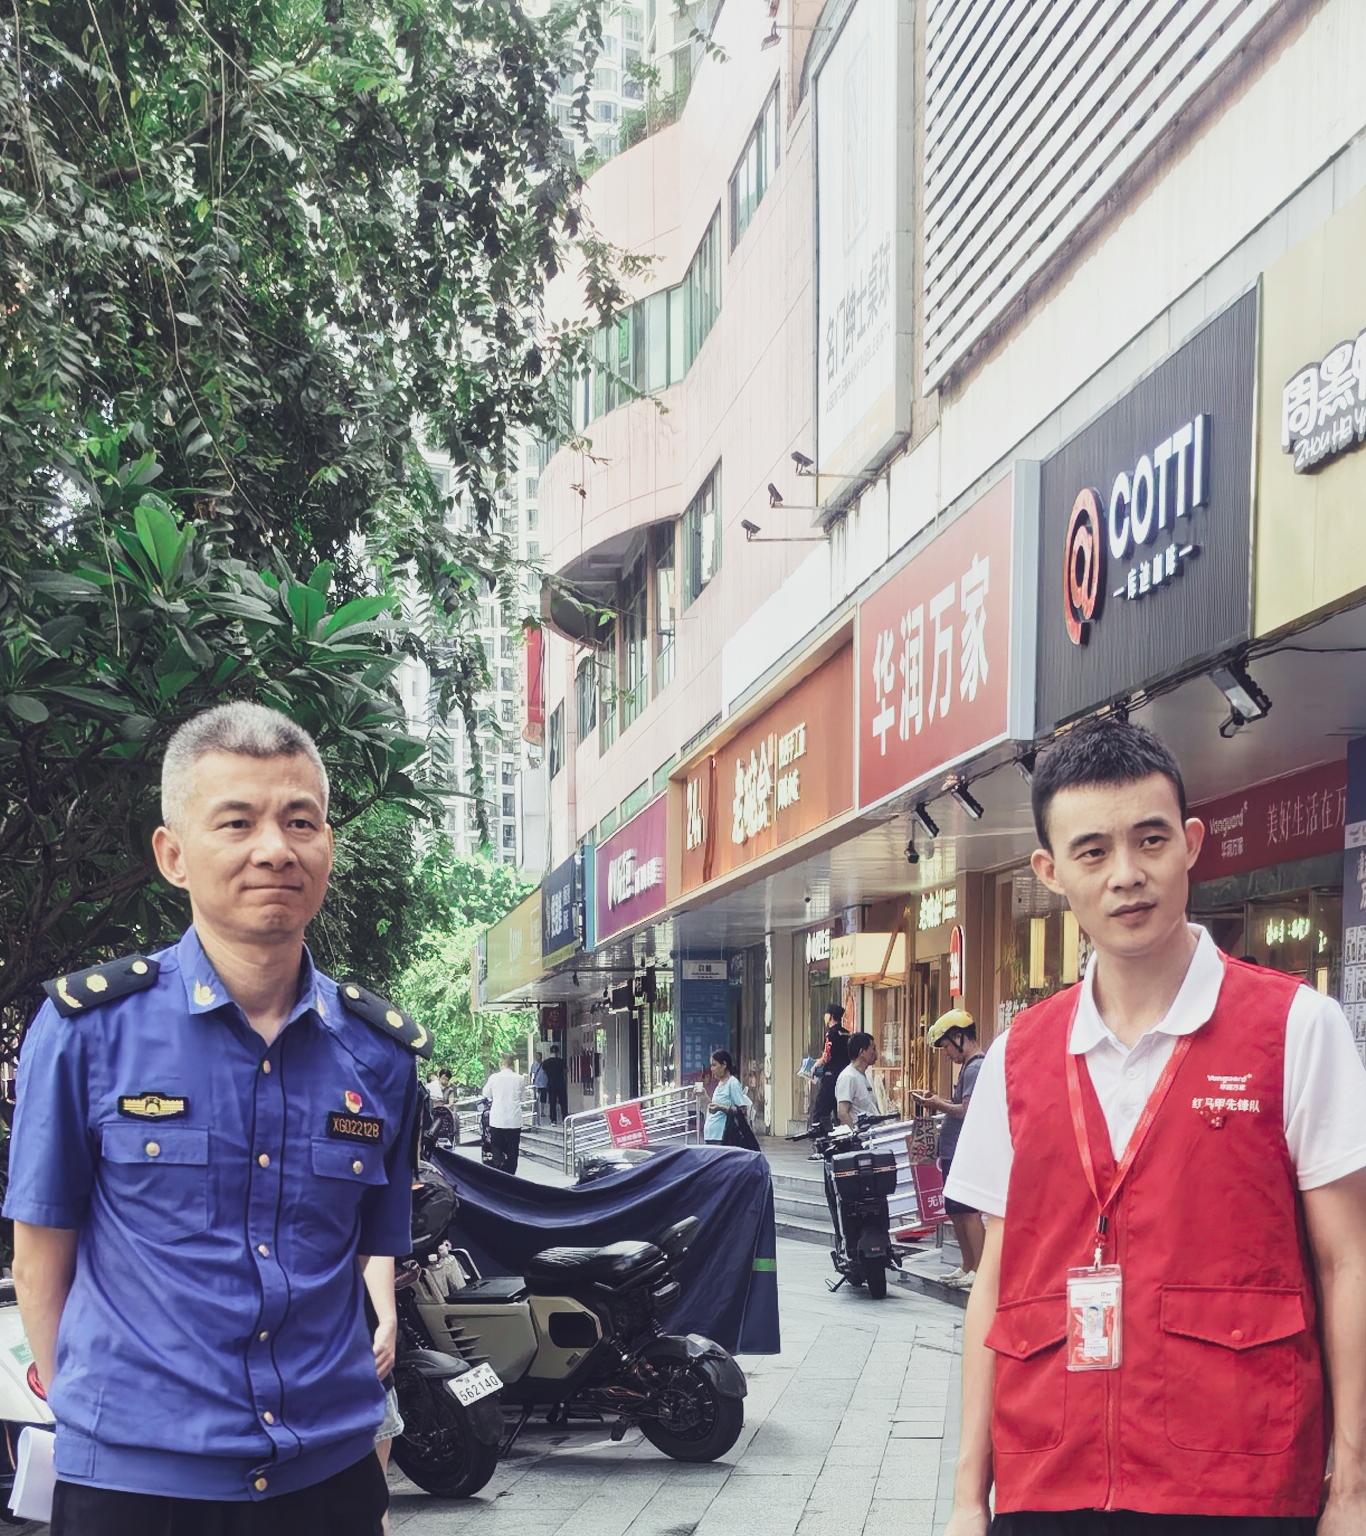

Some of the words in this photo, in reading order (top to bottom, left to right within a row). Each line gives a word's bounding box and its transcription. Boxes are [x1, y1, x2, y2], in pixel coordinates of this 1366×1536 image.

[1109, 414, 1203, 559] COTTI
[871, 552, 990, 757] 华润万家
[459, 1375, 499, 1401] 562140
